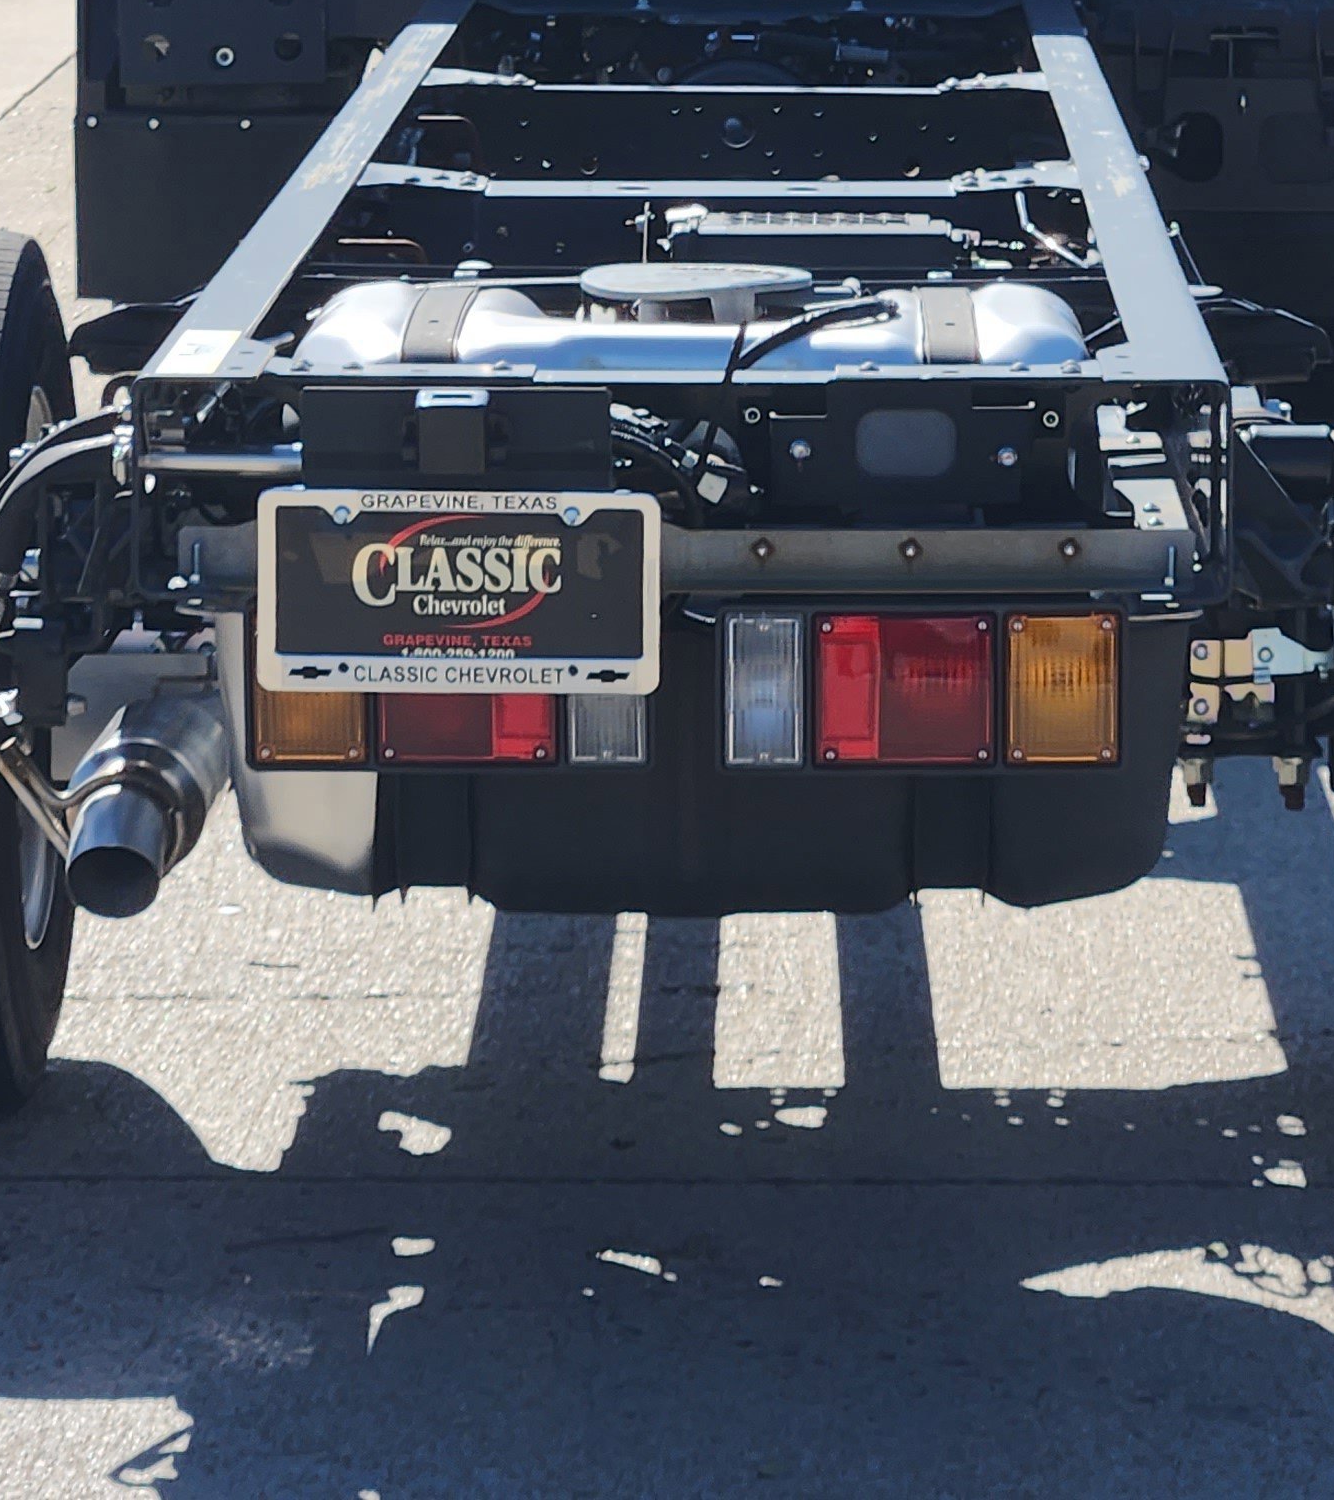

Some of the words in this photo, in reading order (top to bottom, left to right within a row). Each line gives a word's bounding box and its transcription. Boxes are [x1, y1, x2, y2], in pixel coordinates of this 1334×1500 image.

[361, 494, 484, 510] GRAPEVINE,
[492, 495, 558, 510] TEXAS
[472, 535, 497, 549] enjoy
[498, 535, 513, 547] the
[514, 533, 562, 549] difference.
[352, 543, 562, 607] CLASSIC
[413, 594, 507, 616] Chevrolet
[383, 633, 476, 648] GRAPEVINE,
[481, 635, 532, 647] TEXAS
[354, 665, 438, 684] CLASSIC
[445, 667, 564, 685] CHEVROLET
